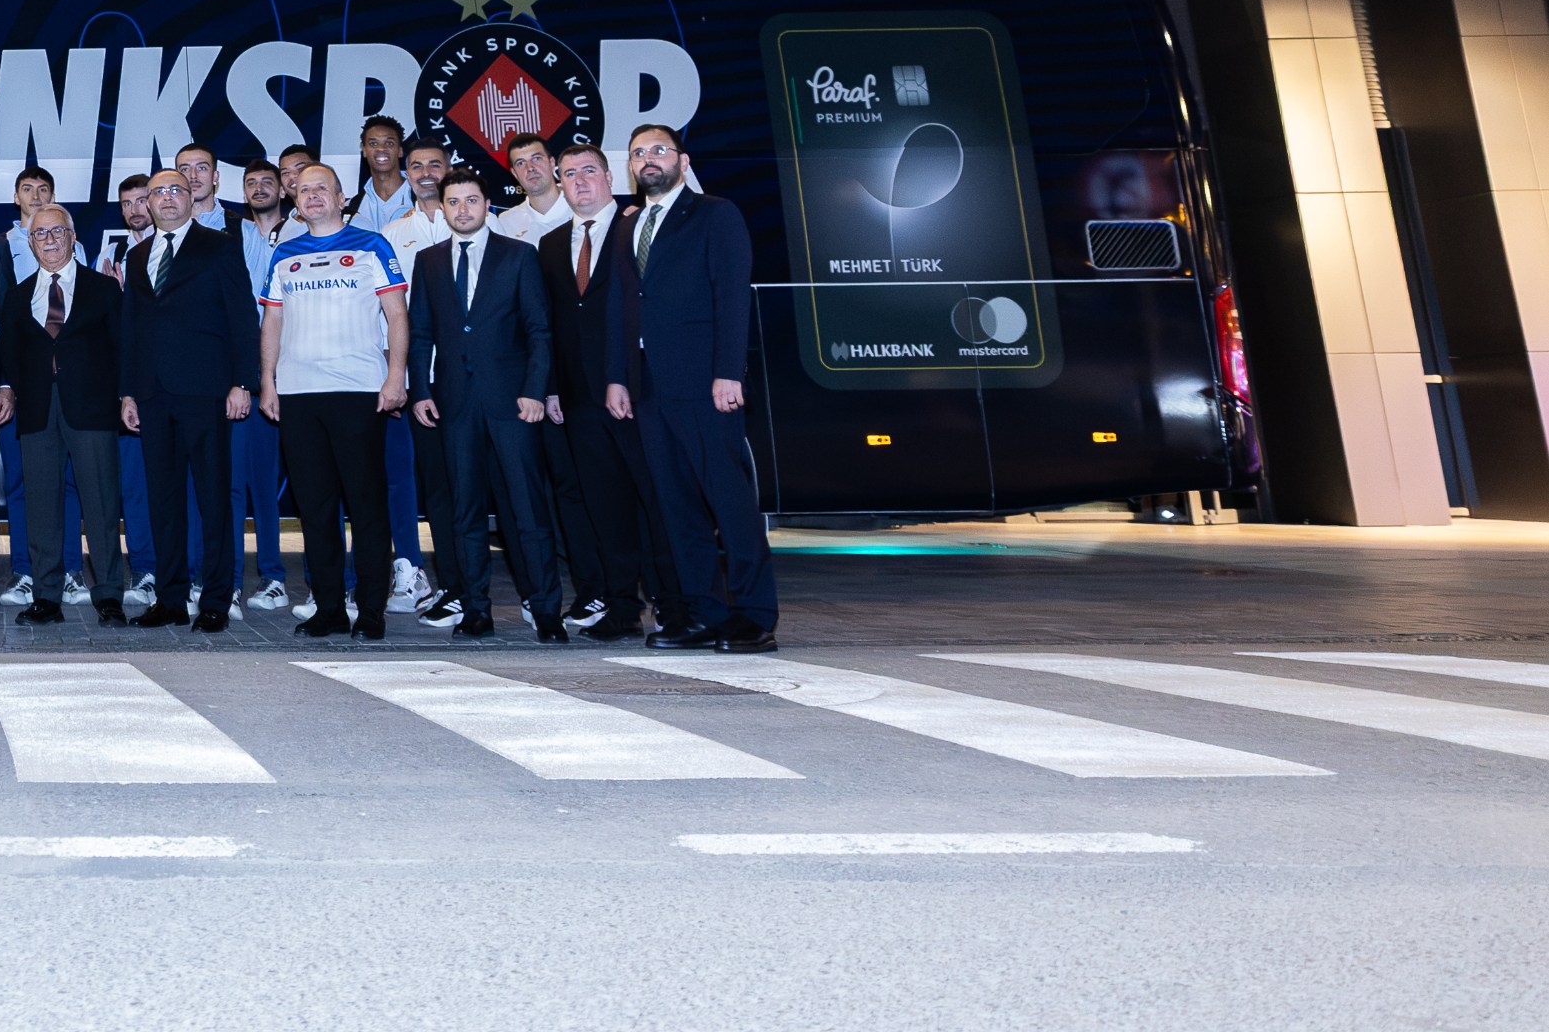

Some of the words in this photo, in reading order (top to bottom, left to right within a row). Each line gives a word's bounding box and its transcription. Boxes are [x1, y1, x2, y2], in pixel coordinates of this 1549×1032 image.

[429, 48, 480, 175] ALKBANK
[486, 37, 558, 67] SPOR
[816, 112, 883, 123] PREMIUM
[503, 185, 527, 195] 198
[829, 259, 892, 273] MEHMET
[900, 258, 943, 272] TÜRK
[294, 278, 358, 291] HALKBANK
[850, 343, 935, 357] HALKBANK
[958, 345, 1029, 356] mastercard
